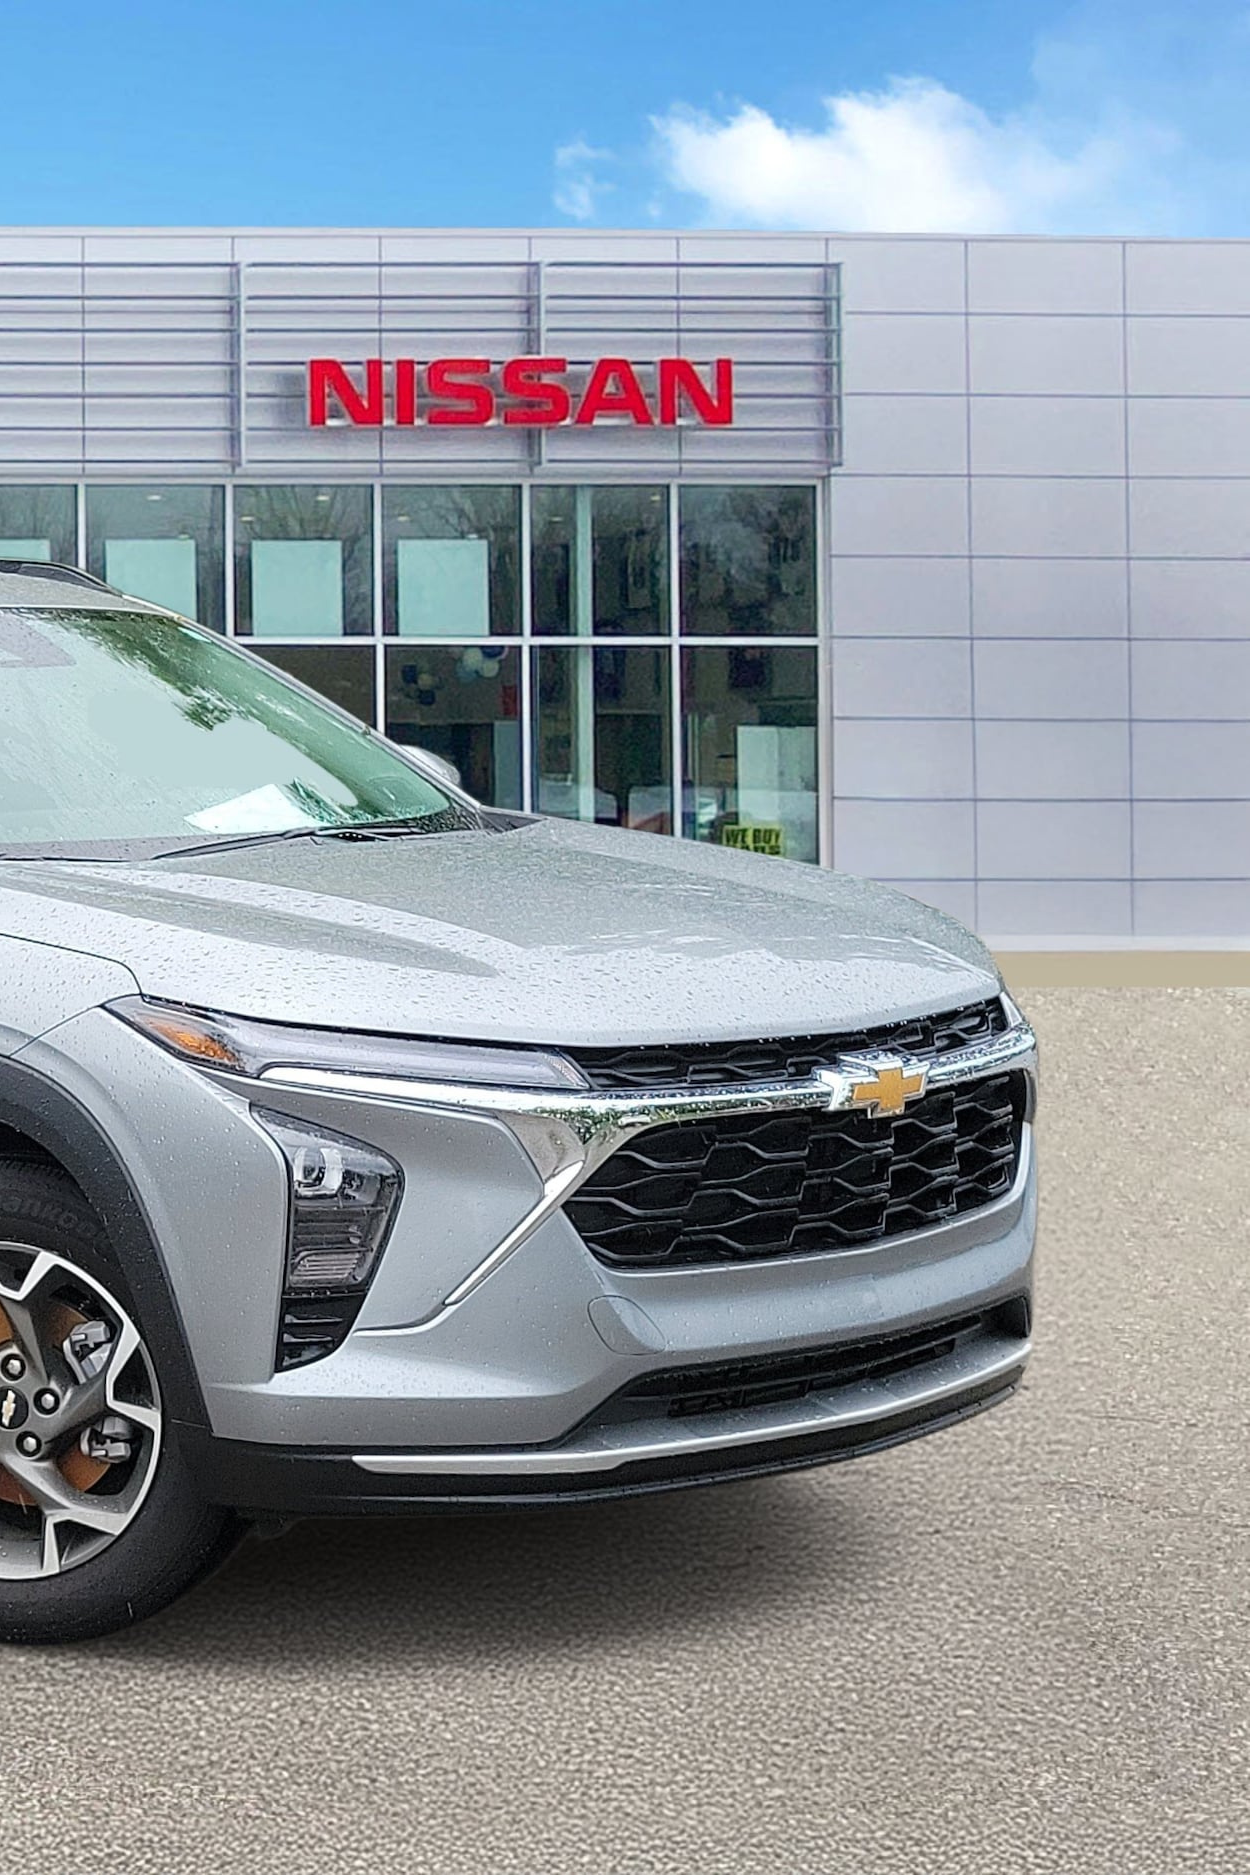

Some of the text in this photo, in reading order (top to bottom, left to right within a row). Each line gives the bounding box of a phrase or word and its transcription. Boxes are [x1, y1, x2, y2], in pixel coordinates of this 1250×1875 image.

[308, 357, 733, 427] NISSAN
[725, 828, 782, 844] WE BUY
